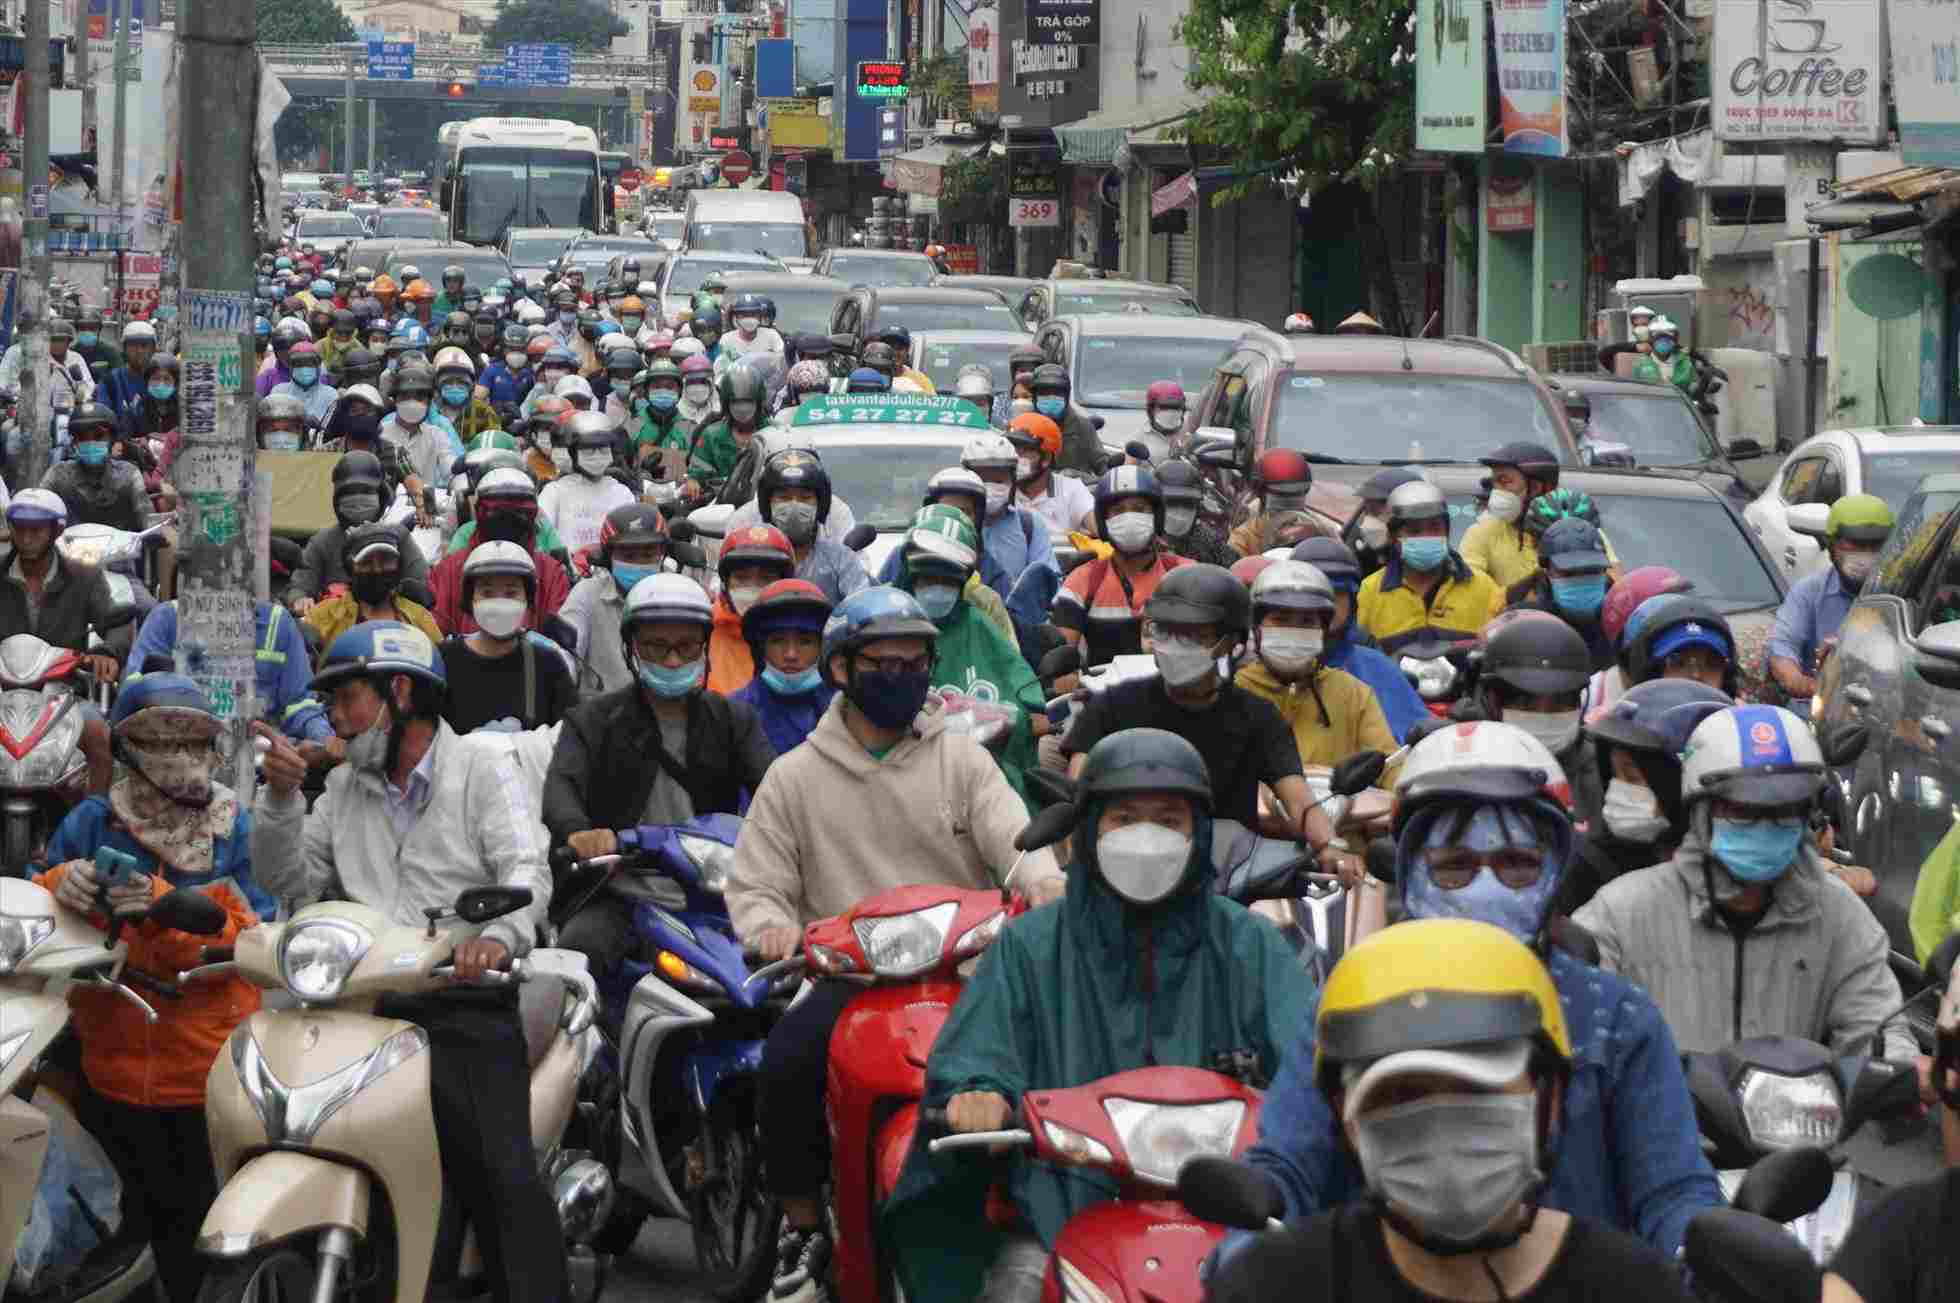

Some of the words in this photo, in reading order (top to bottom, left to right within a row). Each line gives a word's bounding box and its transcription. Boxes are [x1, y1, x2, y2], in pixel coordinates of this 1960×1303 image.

[1054, 31, 1072, 42] 0%
[1730, 57, 1868, 97] Coffee
[1018, 203, 1051, 218] 369
[808, 408, 842, 421] 54
[851, 408, 886, 421] 27
[895, 409, 929, 422] 27
[938, 411, 972, 424] 27
